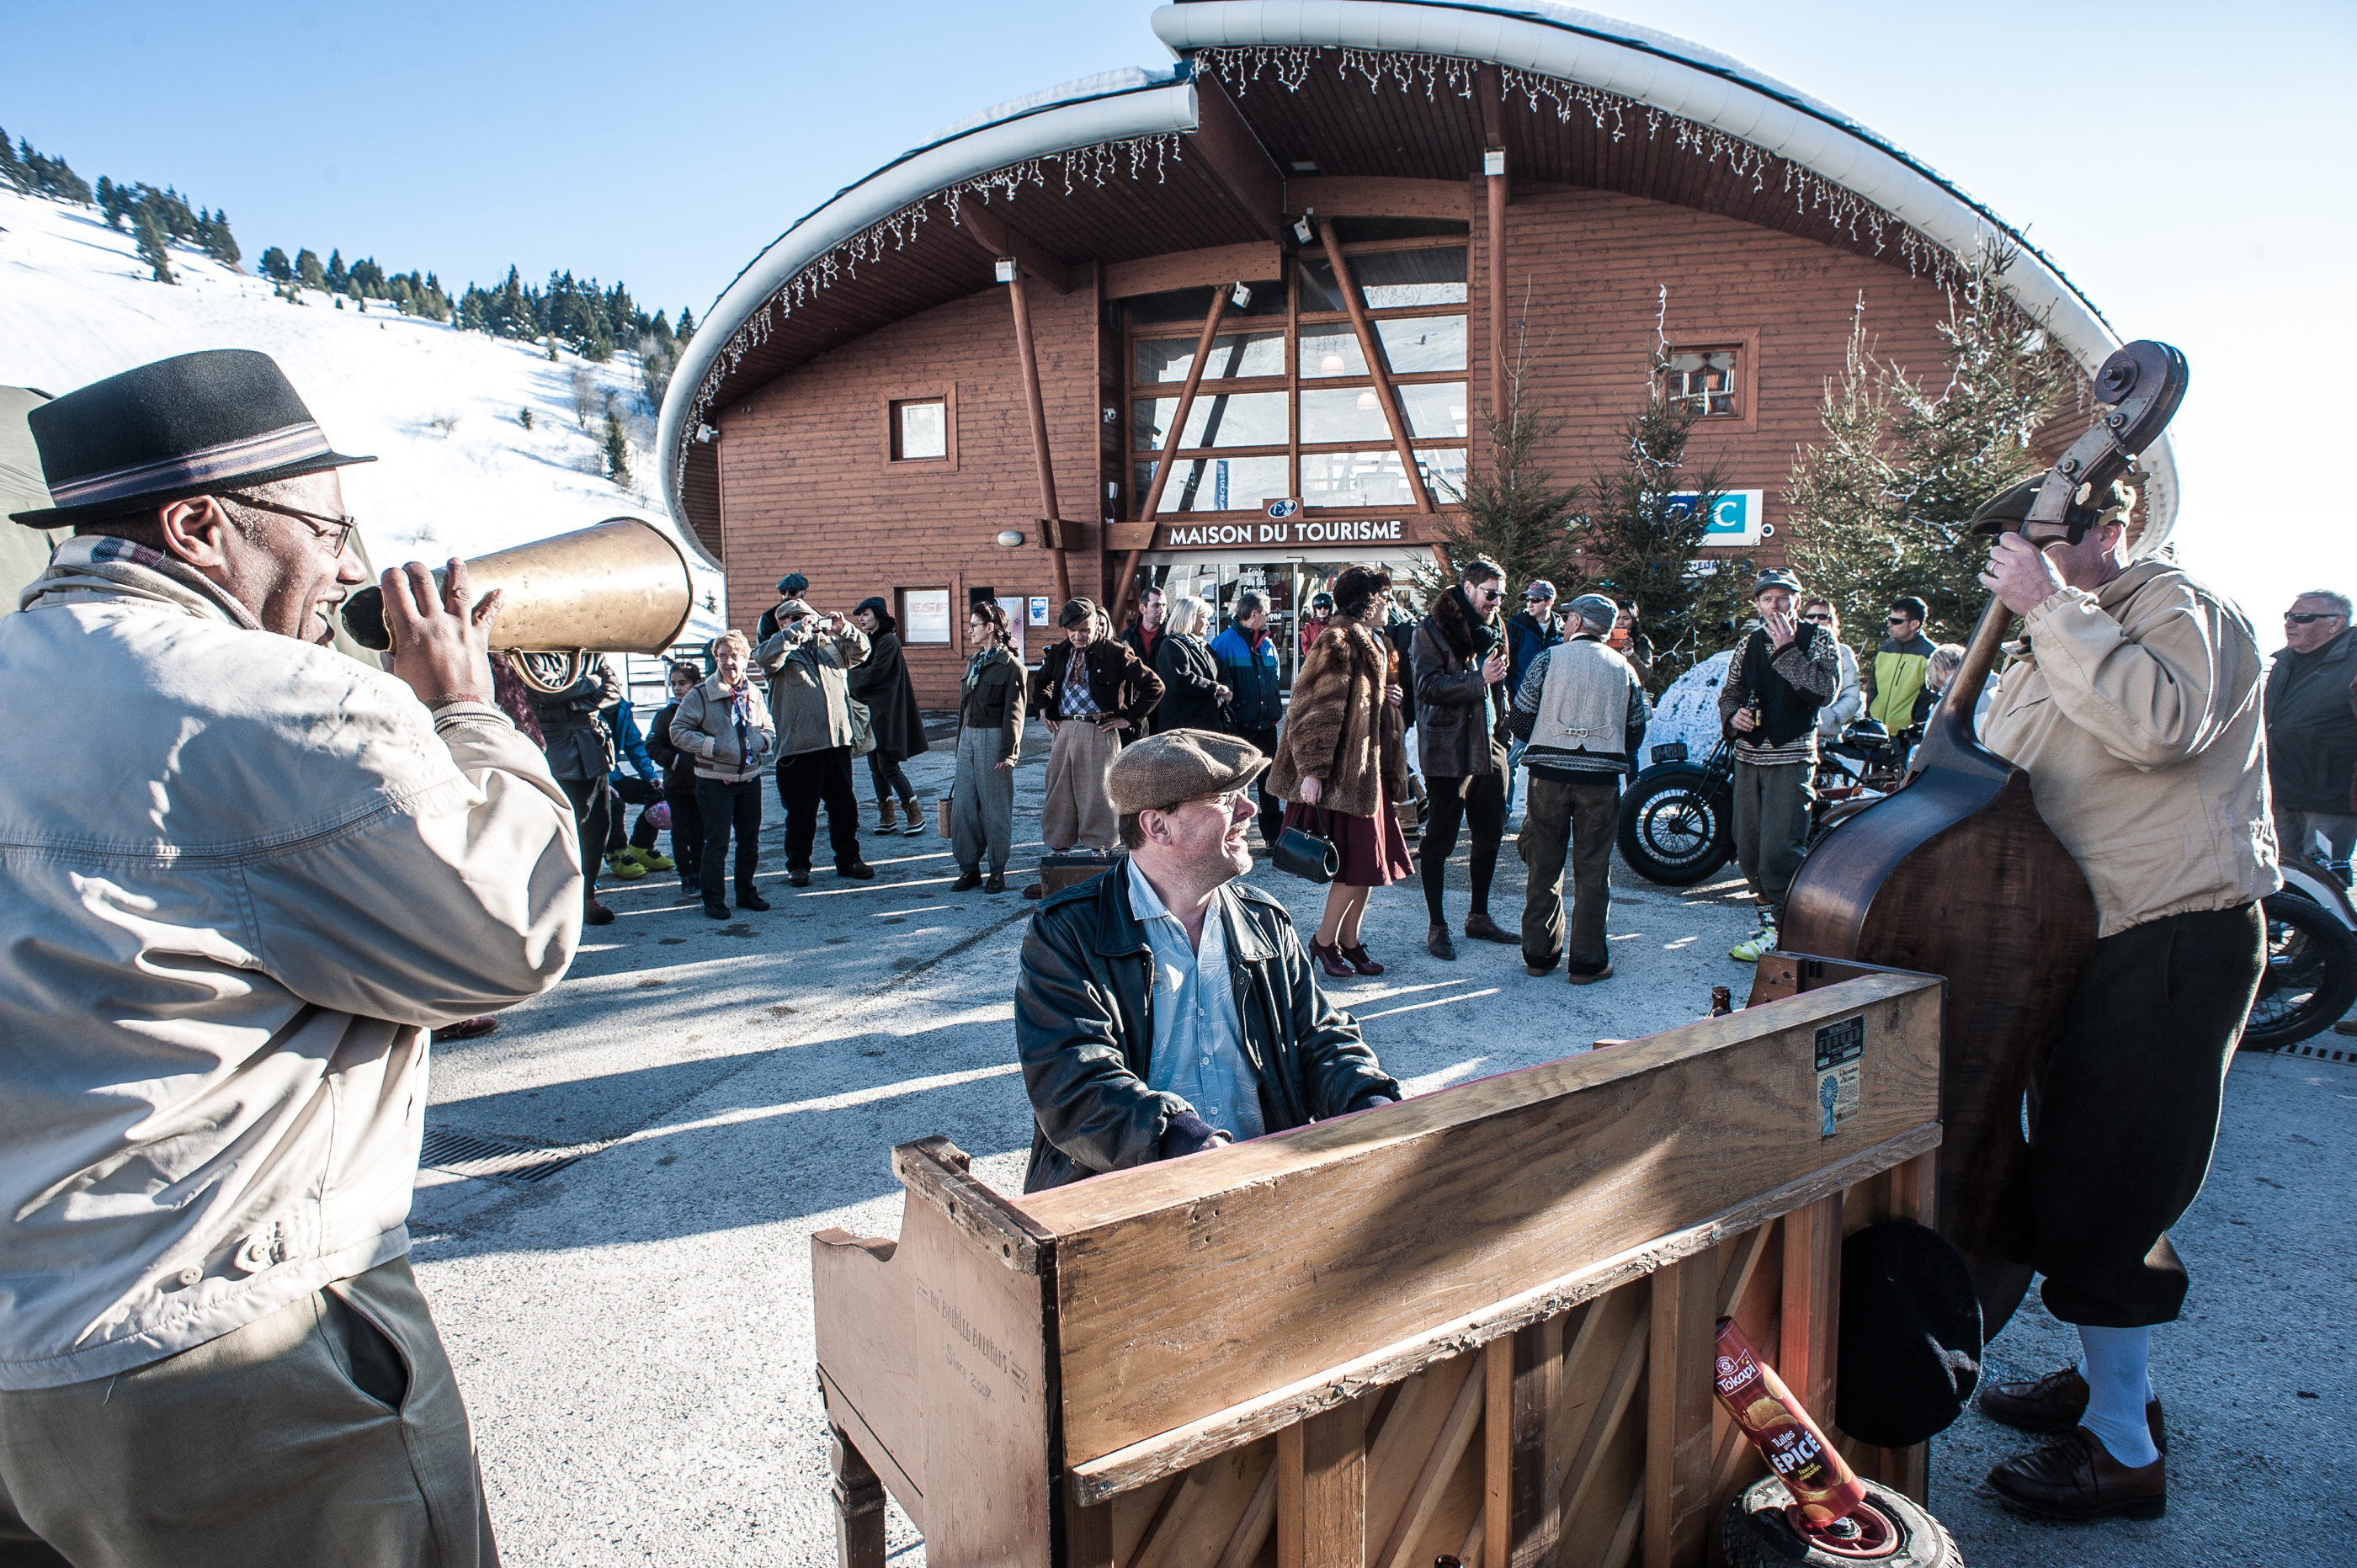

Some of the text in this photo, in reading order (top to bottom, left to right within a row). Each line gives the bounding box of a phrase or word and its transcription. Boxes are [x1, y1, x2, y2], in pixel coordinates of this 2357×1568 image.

[1170, 520, 1402, 545] MAISON DU TOURISME
[1248, 567, 1265, 577] Ecole
[1246, 577, 1267, 587] du Ski
[907, 602, 950, 613] ESF
[929, 1289, 939, 1312] THE
[1716, 1363, 1756, 1392] Tokapi
[1771, 1429, 1796, 1448] Tuiles
[1770, 1430, 1822, 1475] ÉPICÉ
[1798, 1465, 1811, 1475] Fines
